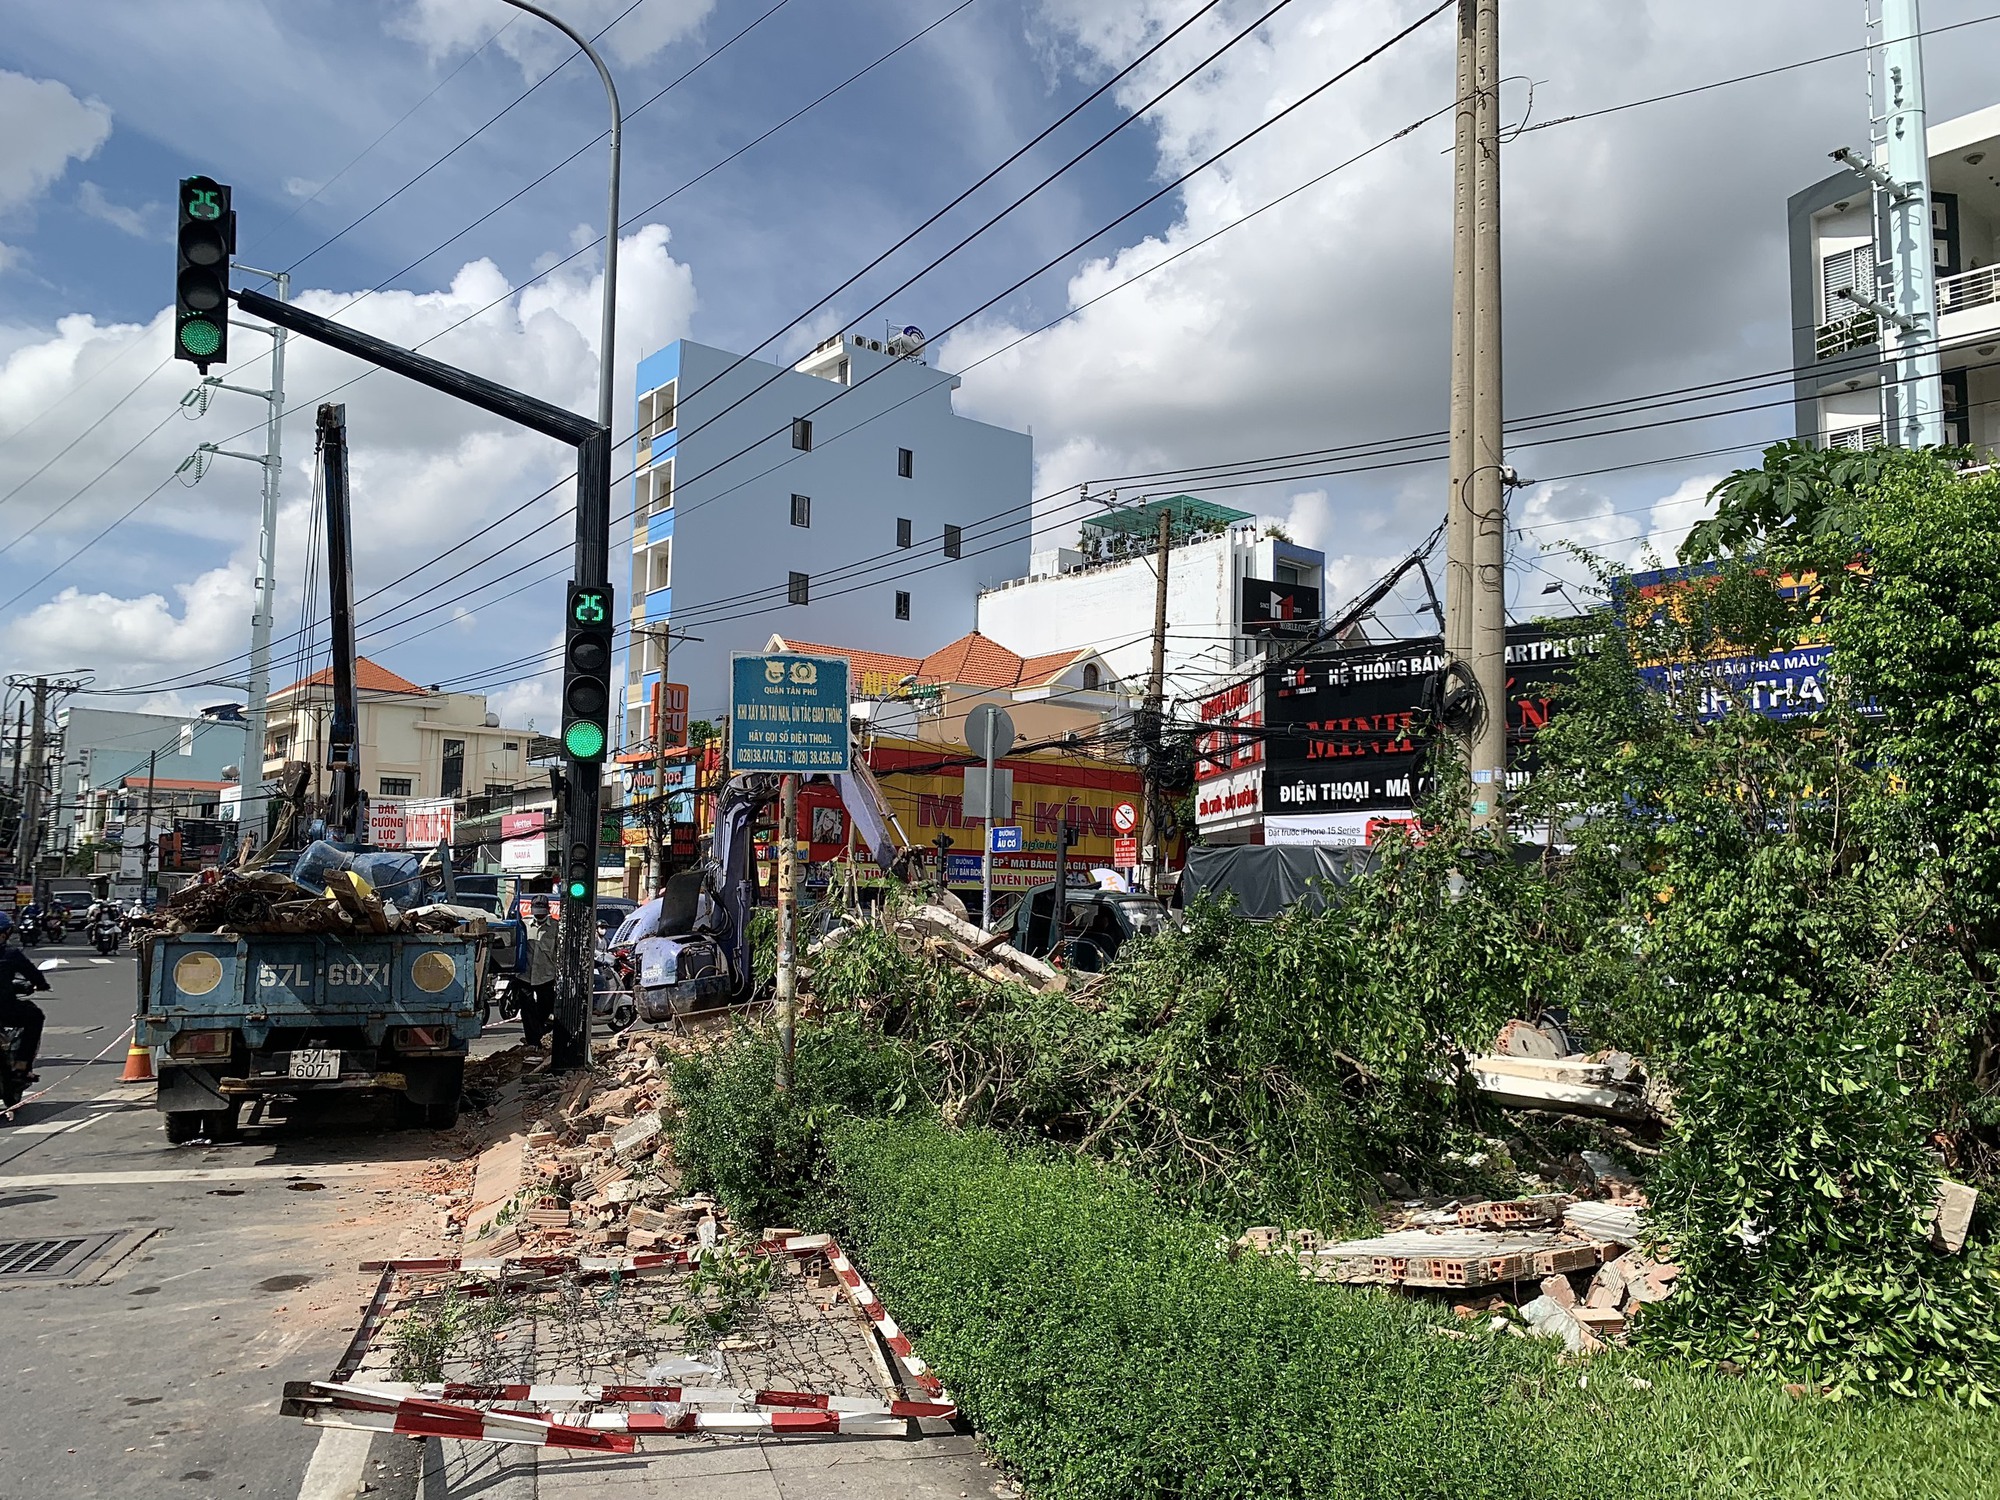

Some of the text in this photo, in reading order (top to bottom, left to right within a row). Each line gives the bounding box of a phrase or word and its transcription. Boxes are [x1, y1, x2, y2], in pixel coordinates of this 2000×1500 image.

[190, 189, 220, 218] 25
[577, 595, 603, 621] 25
[1329, 650, 1445, 687] HỆ THỐNG BÁN
[1750, 660, 1780, 674] PHA
[1784, 653, 1821, 670] MÀU
[764, 686, 818, 697] QUẬN TÂN PHÚ
[737, 704, 747, 720] KHI
[760, 704, 768, 721] RA
[768, 704, 778, 721] TAI
[749, 729, 832, 746] HÃY GỌI SỐ ĐIỆN THOẠI:
[1306, 711, 1414, 759] MINH
[792, 750, 808, 765] (028)
[634, 771, 652, 788] Nha
[1280, 779, 1317, 806] ĐIỆN
[1320, 780, 1369, 803] THOẠI
[378, 803, 398, 815] DÁN
[371, 815, 403, 828] CƯỜNG
[513, 819, 532, 829] viettel
[378, 828, 396, 842] LỰC
[999, 829, 1016, 837] ĐƯỜNG
[1268, 825, 1361, 839] Đặt trước iPhone 15 Series
[997, 838, 1017, 848] ÂU CƠ
[956, 857, 974, 866] ĐƯỜNG
[259, 963, 310, 987] 57L
[328, 963, 390, 986] 6071
[301, 1050, 330, 1064] 57L
[295, 1063, 331, 1078] 6071
